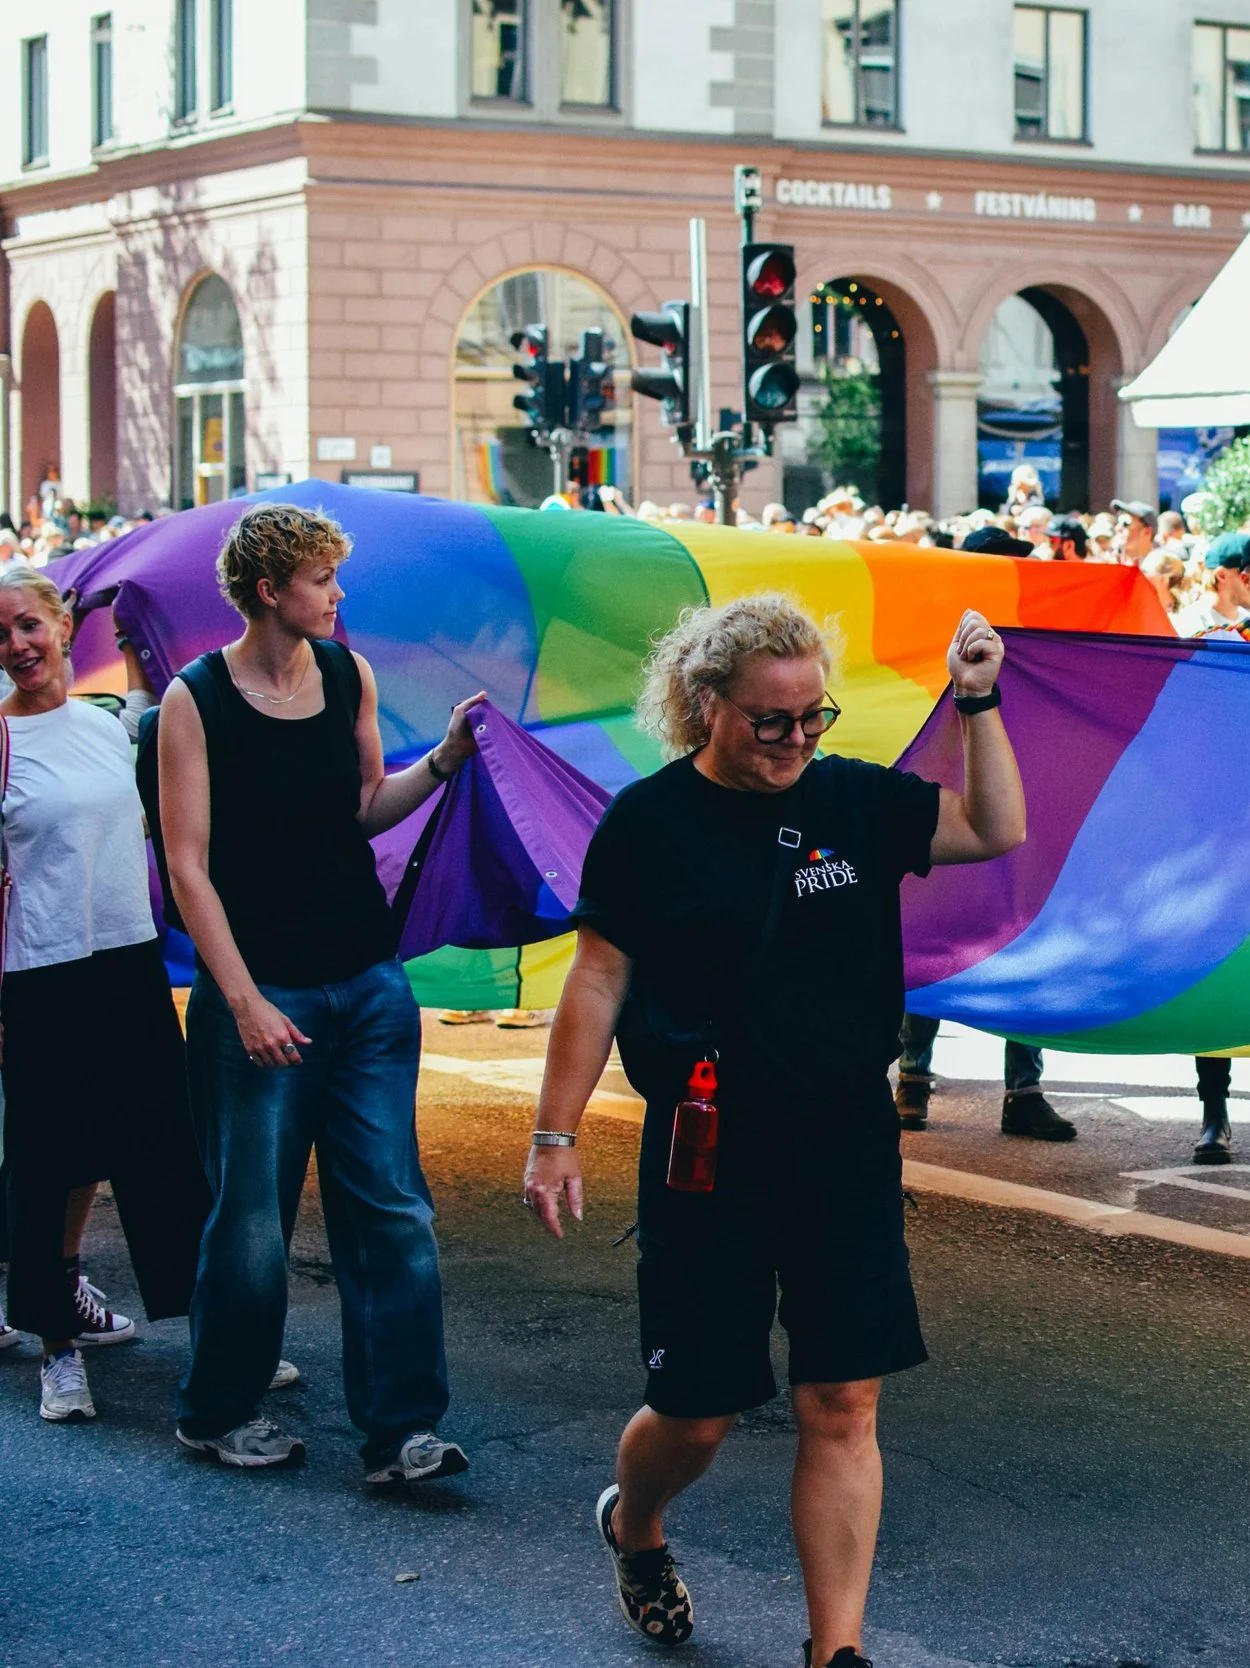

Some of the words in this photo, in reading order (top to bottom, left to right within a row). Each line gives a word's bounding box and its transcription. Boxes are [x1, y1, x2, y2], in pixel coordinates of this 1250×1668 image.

[776, 179, 891, 209] COCKTAILS
[1172, 203, 1212, 228] BAR
[794, 867, 858, 897] PRIDE
[795, 860, 851, 880] SVENSKA
